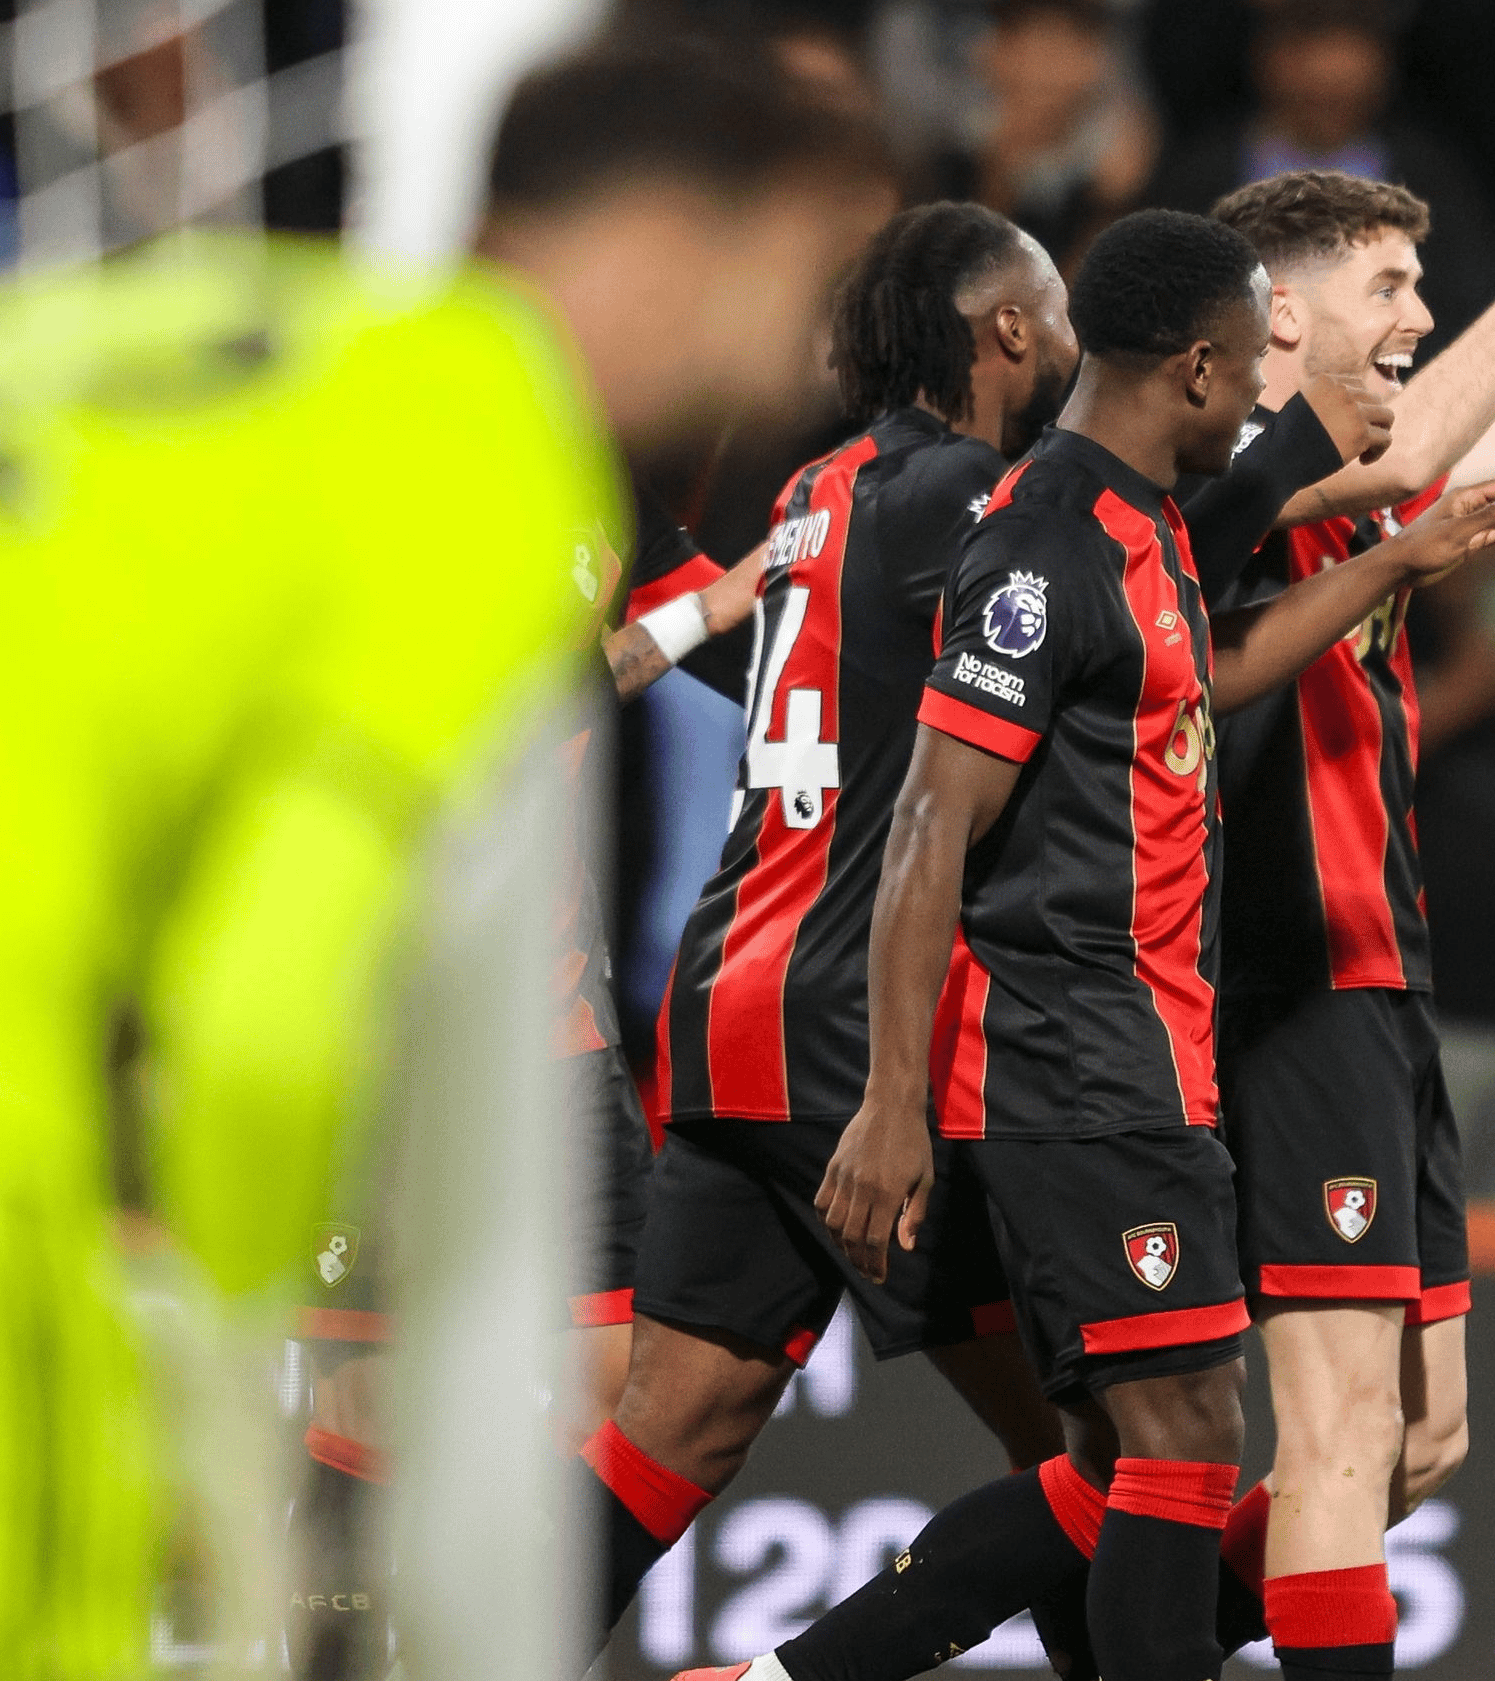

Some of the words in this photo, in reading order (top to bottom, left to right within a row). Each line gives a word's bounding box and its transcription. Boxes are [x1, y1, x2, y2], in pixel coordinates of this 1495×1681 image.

[953, 666, 977, 684] for
[975, 674, 1026, 707] racism
[957, 652, 982, 673] No
[981, 662, 1024, 692] room
[727, 586, 840, 830] 4
[290, 1592, 370, 1611] AFCB
